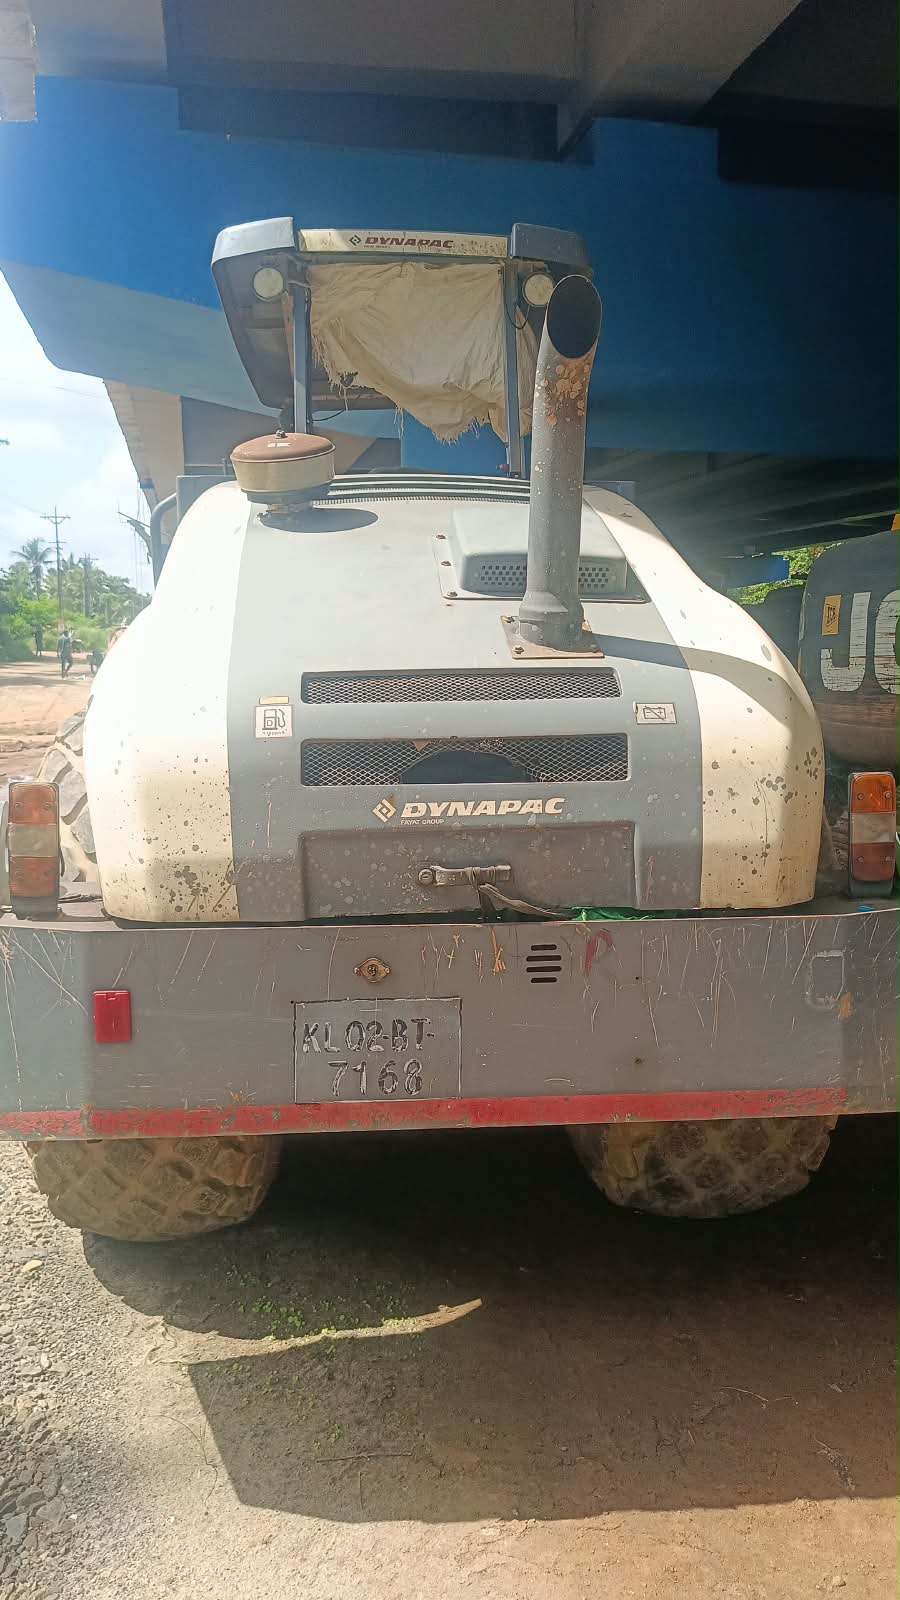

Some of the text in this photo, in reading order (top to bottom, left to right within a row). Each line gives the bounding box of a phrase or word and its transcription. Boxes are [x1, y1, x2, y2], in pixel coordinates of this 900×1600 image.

[365, 236, 454, 249] DYNAPAC
[400, 797, 566, 818] DYNAPAC
[421, 818, 445, 826] GROUP
[327, 1058, 423, 1097] 7168
